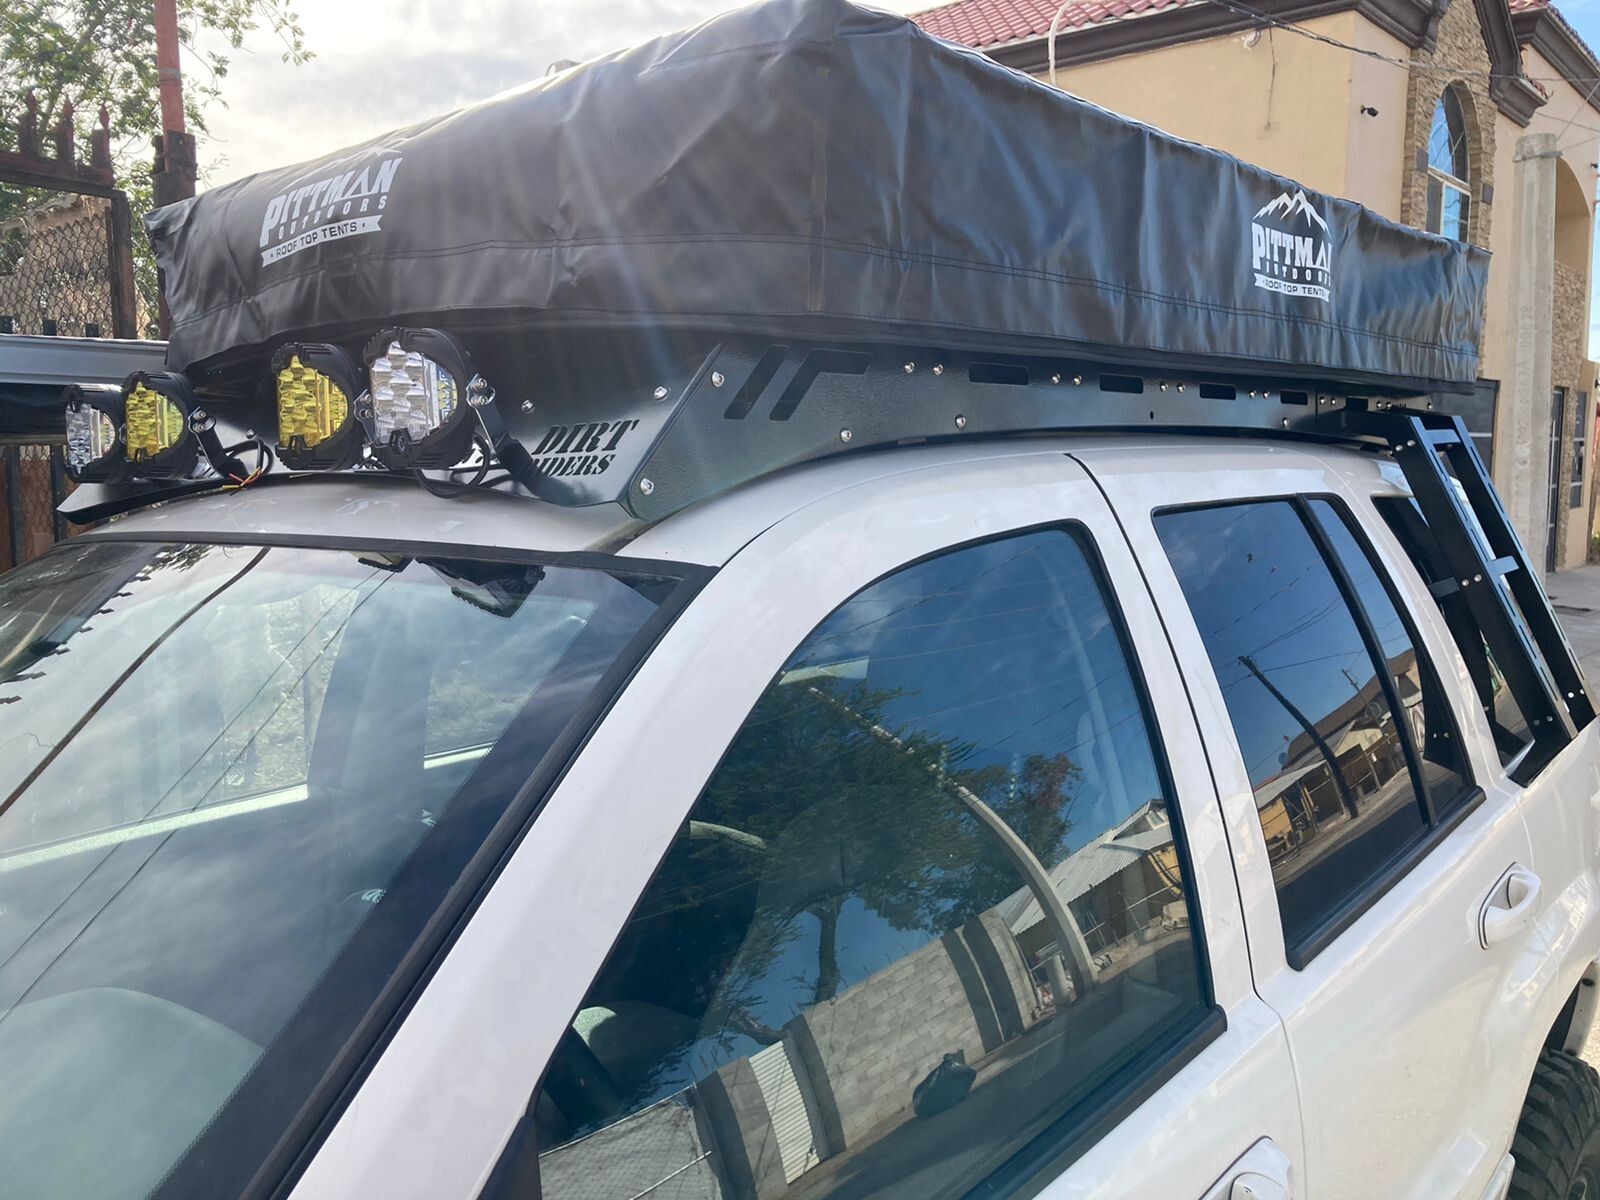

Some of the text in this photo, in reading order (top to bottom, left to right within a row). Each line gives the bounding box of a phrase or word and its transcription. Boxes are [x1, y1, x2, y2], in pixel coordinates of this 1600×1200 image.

[259, 157, 403, 248] PITTMAN
[278, 195, 388, 240] OUTDOORS
[276, 222, 358, 257] ROOF TOP TENTS
[1283, 283, 1298, 293] TOP
[531, 419, 640, 455] DIRT
